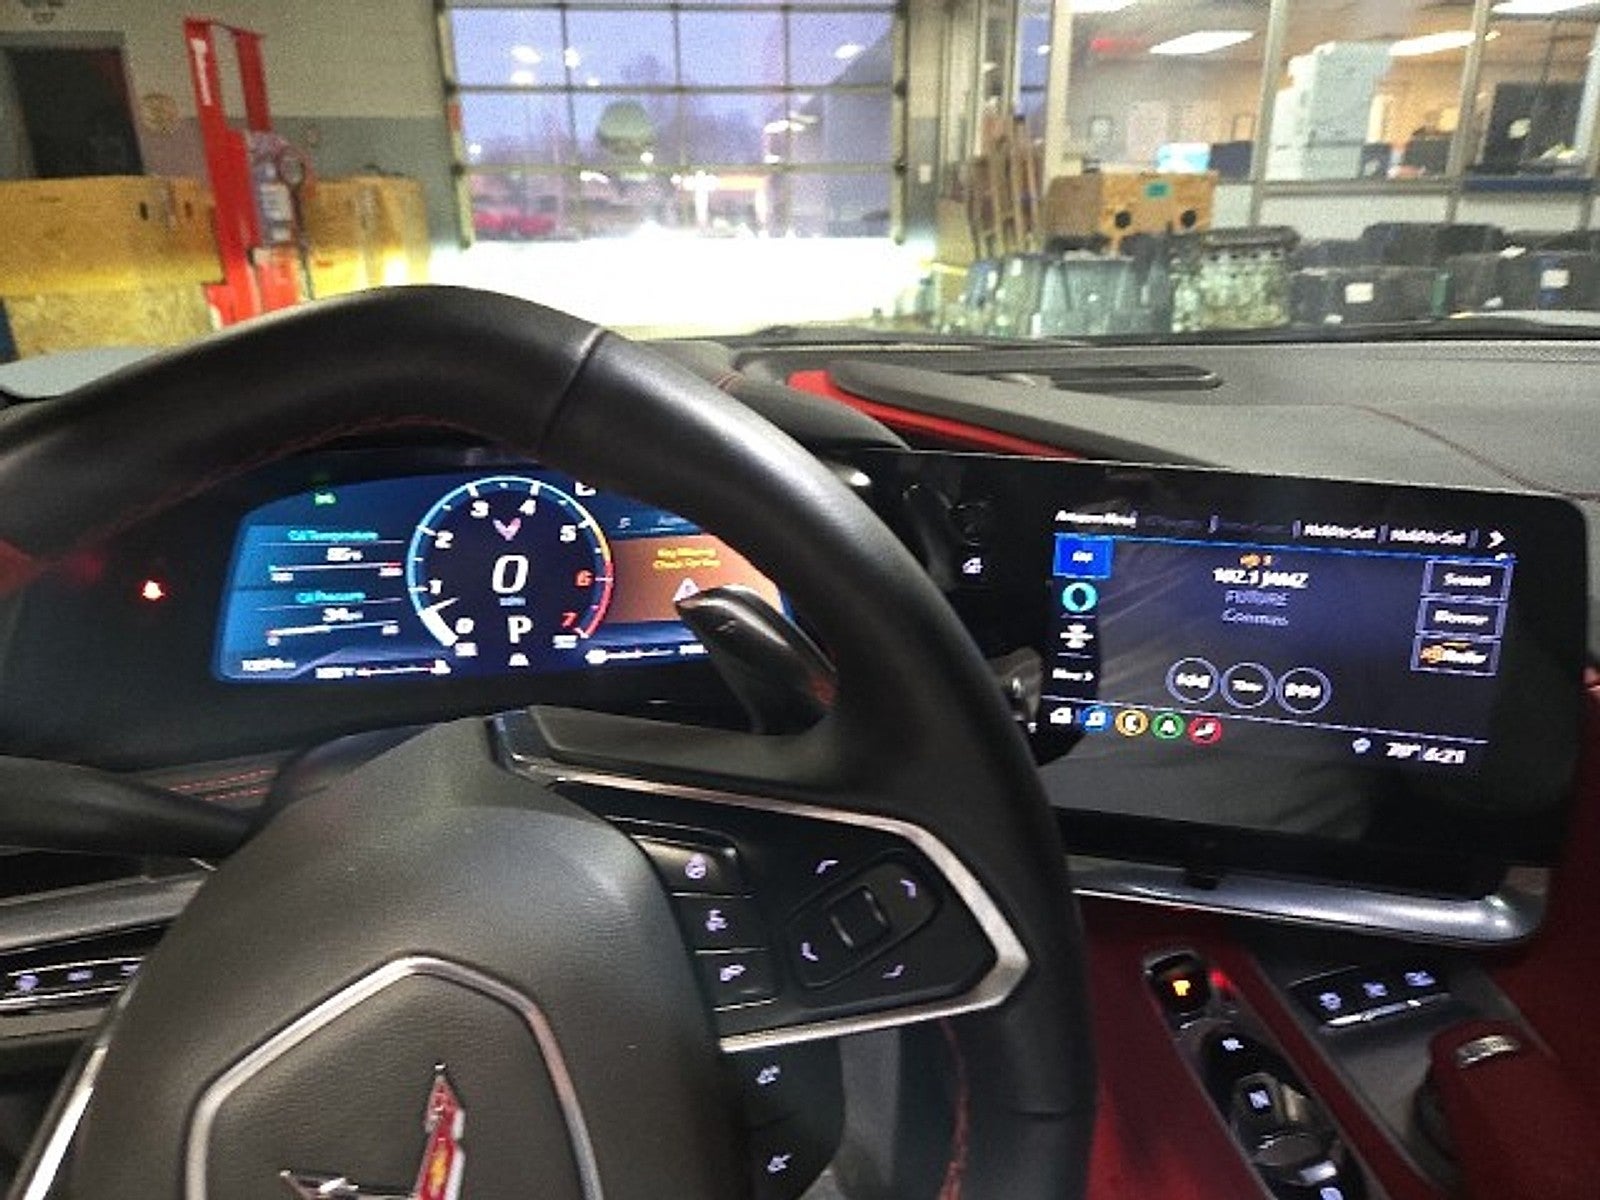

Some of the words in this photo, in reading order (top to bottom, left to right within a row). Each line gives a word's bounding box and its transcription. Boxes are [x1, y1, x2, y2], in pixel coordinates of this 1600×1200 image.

[470, 501, 489, 517] 3
[519, 499, 536, 516] 4
[435, 531, 454, 548] 2
[559, 525, 577, 542] 5
[492, 554, 529, 594] 0
[575, 570, 594, 586] 6
[430, 580, 442, 594] 1
[455, 617, 474, 634] 0
[562, 612, 578, 628] 7
[507, 615, 533, 644] P
